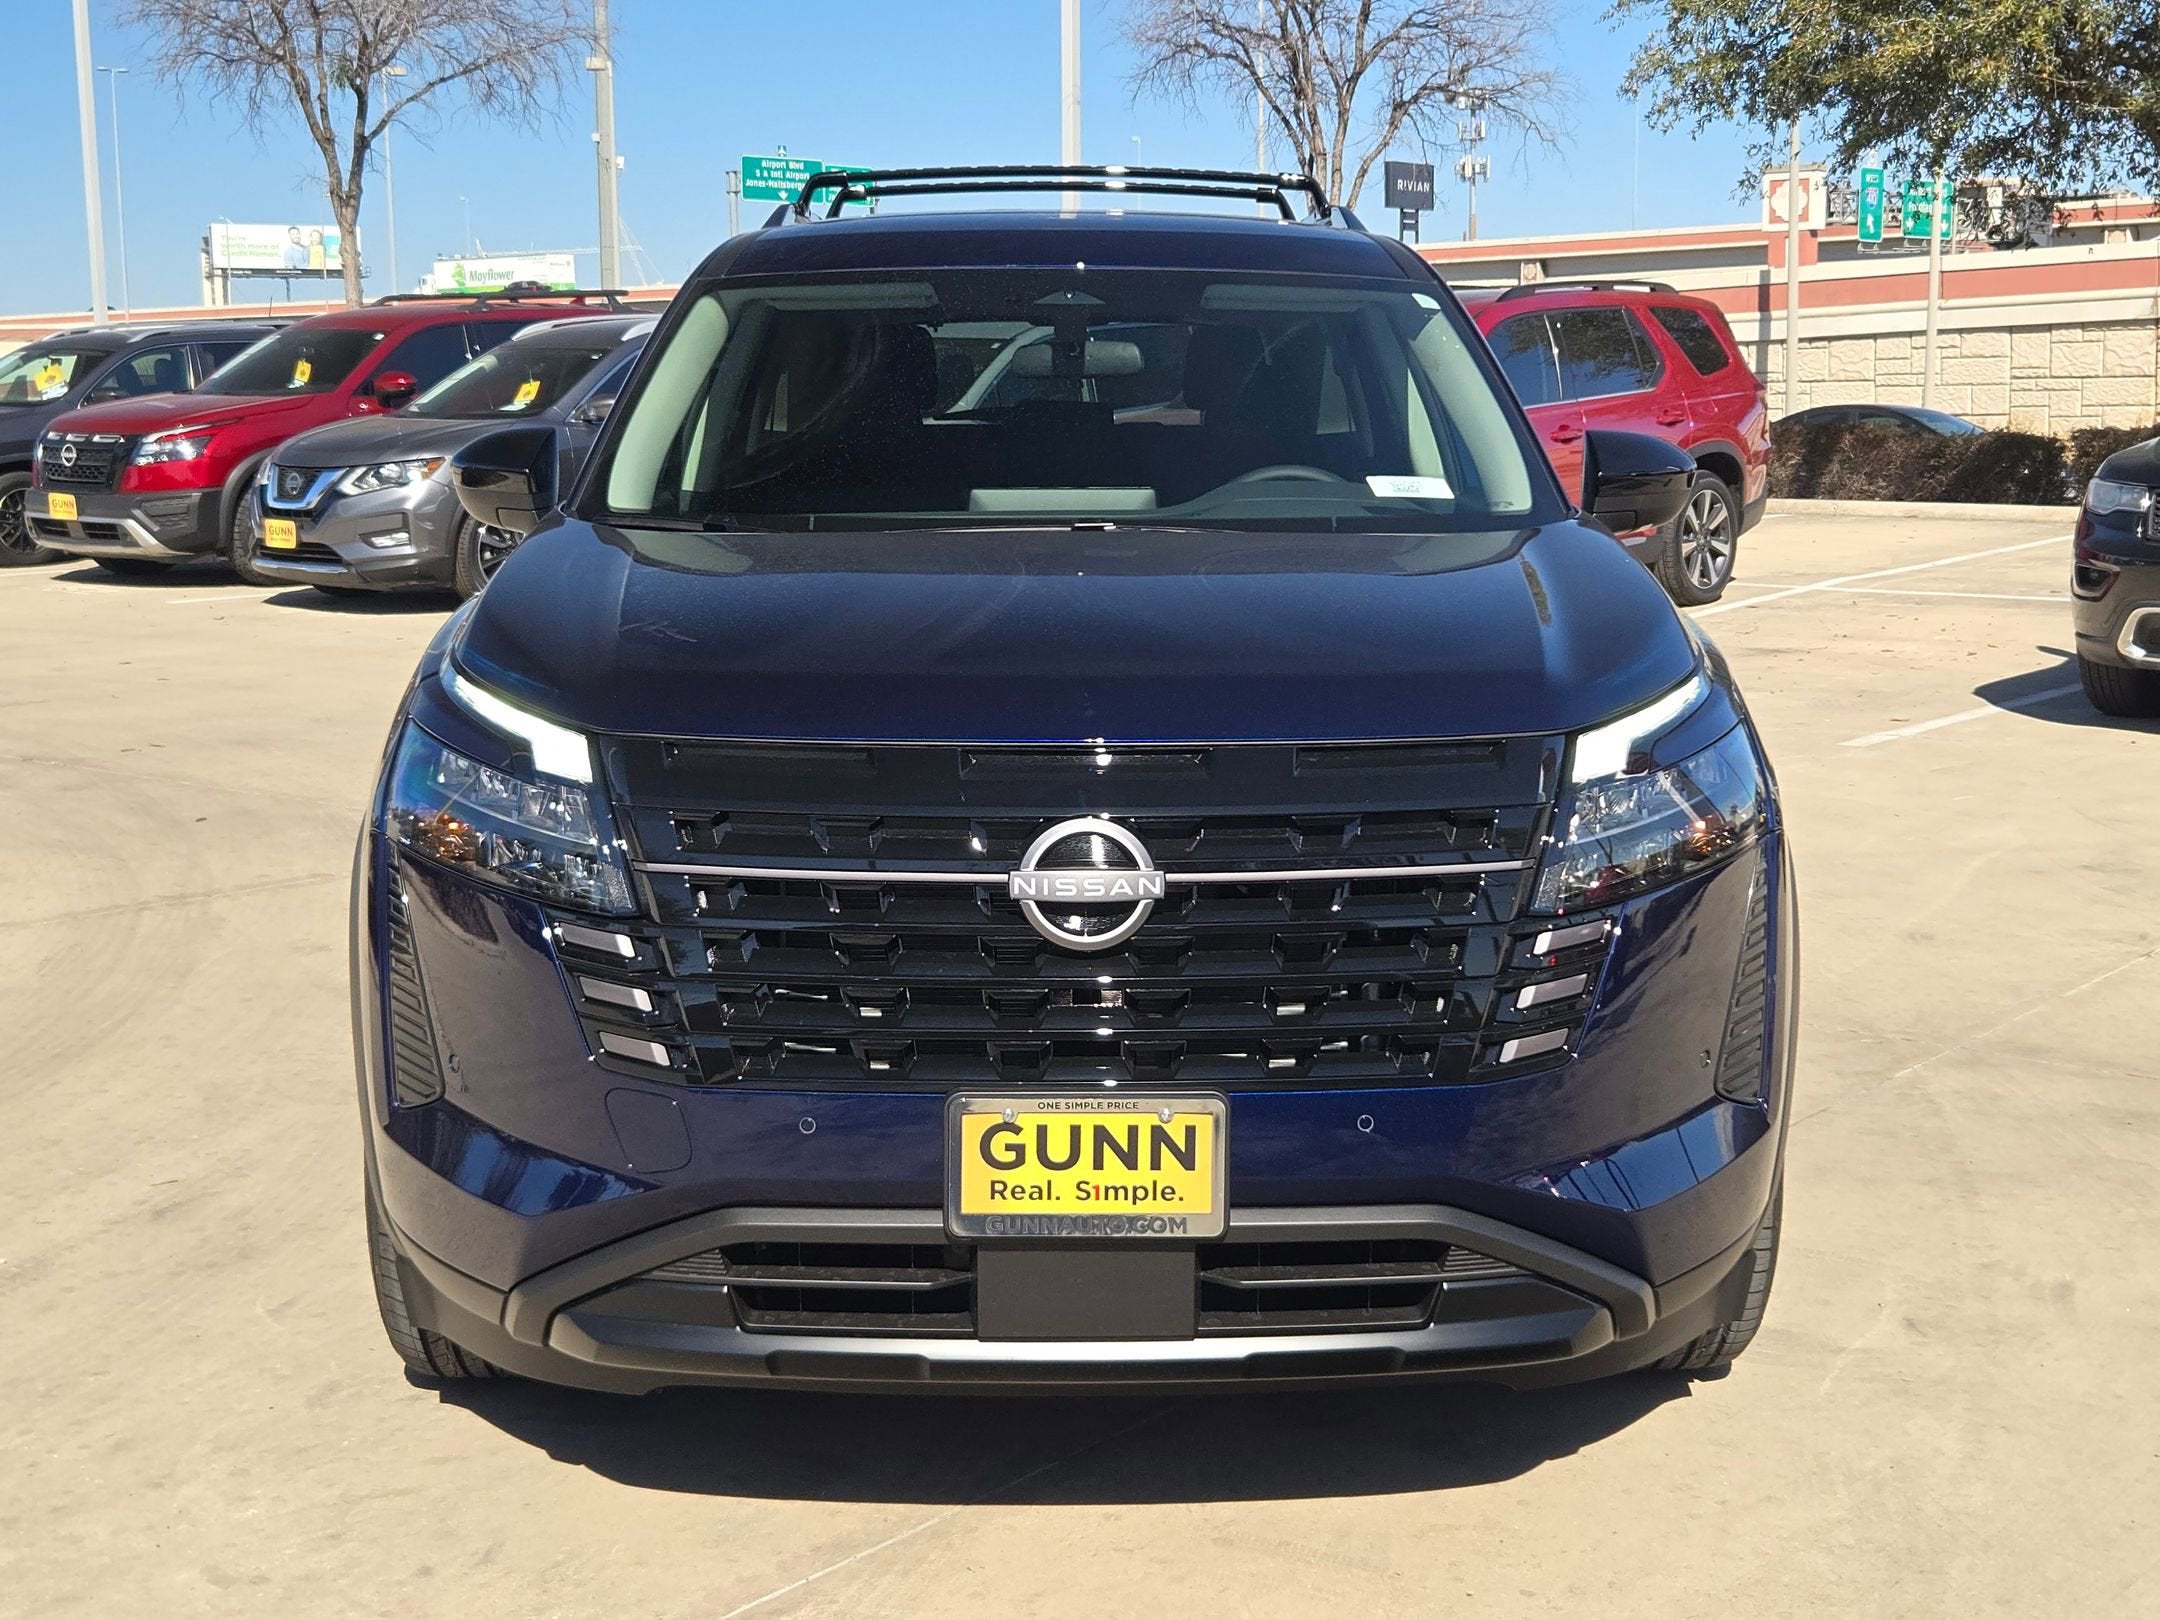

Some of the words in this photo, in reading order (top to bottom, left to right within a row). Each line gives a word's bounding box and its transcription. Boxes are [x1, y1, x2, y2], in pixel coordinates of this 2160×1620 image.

[761, 160, 787, 170] Airport
[789, 161, 804, 170] Blvd
[785, 171, 810, 181] Airport
[1397, 179, 1430, 192] RIVIAN
[469, 268, 515, 284] Mayflower
[52, 499, 75, 509] GUNN
[268, 525, 294, 537] GUNN
[1013, 876, 1161, 896] NISSAN
[1037, 1101, 1061, 1110] ONE
[1064, 1101, 1104, 1110] SIMPLE
[1107, 1101, 1139, 1110] PRICE
[979, 1122, 1196, 1171] GUNN
[990, 1179, 1061, 1201] Real.
[985, 1215, 1187, 1235] GUNNAUTO.COM
